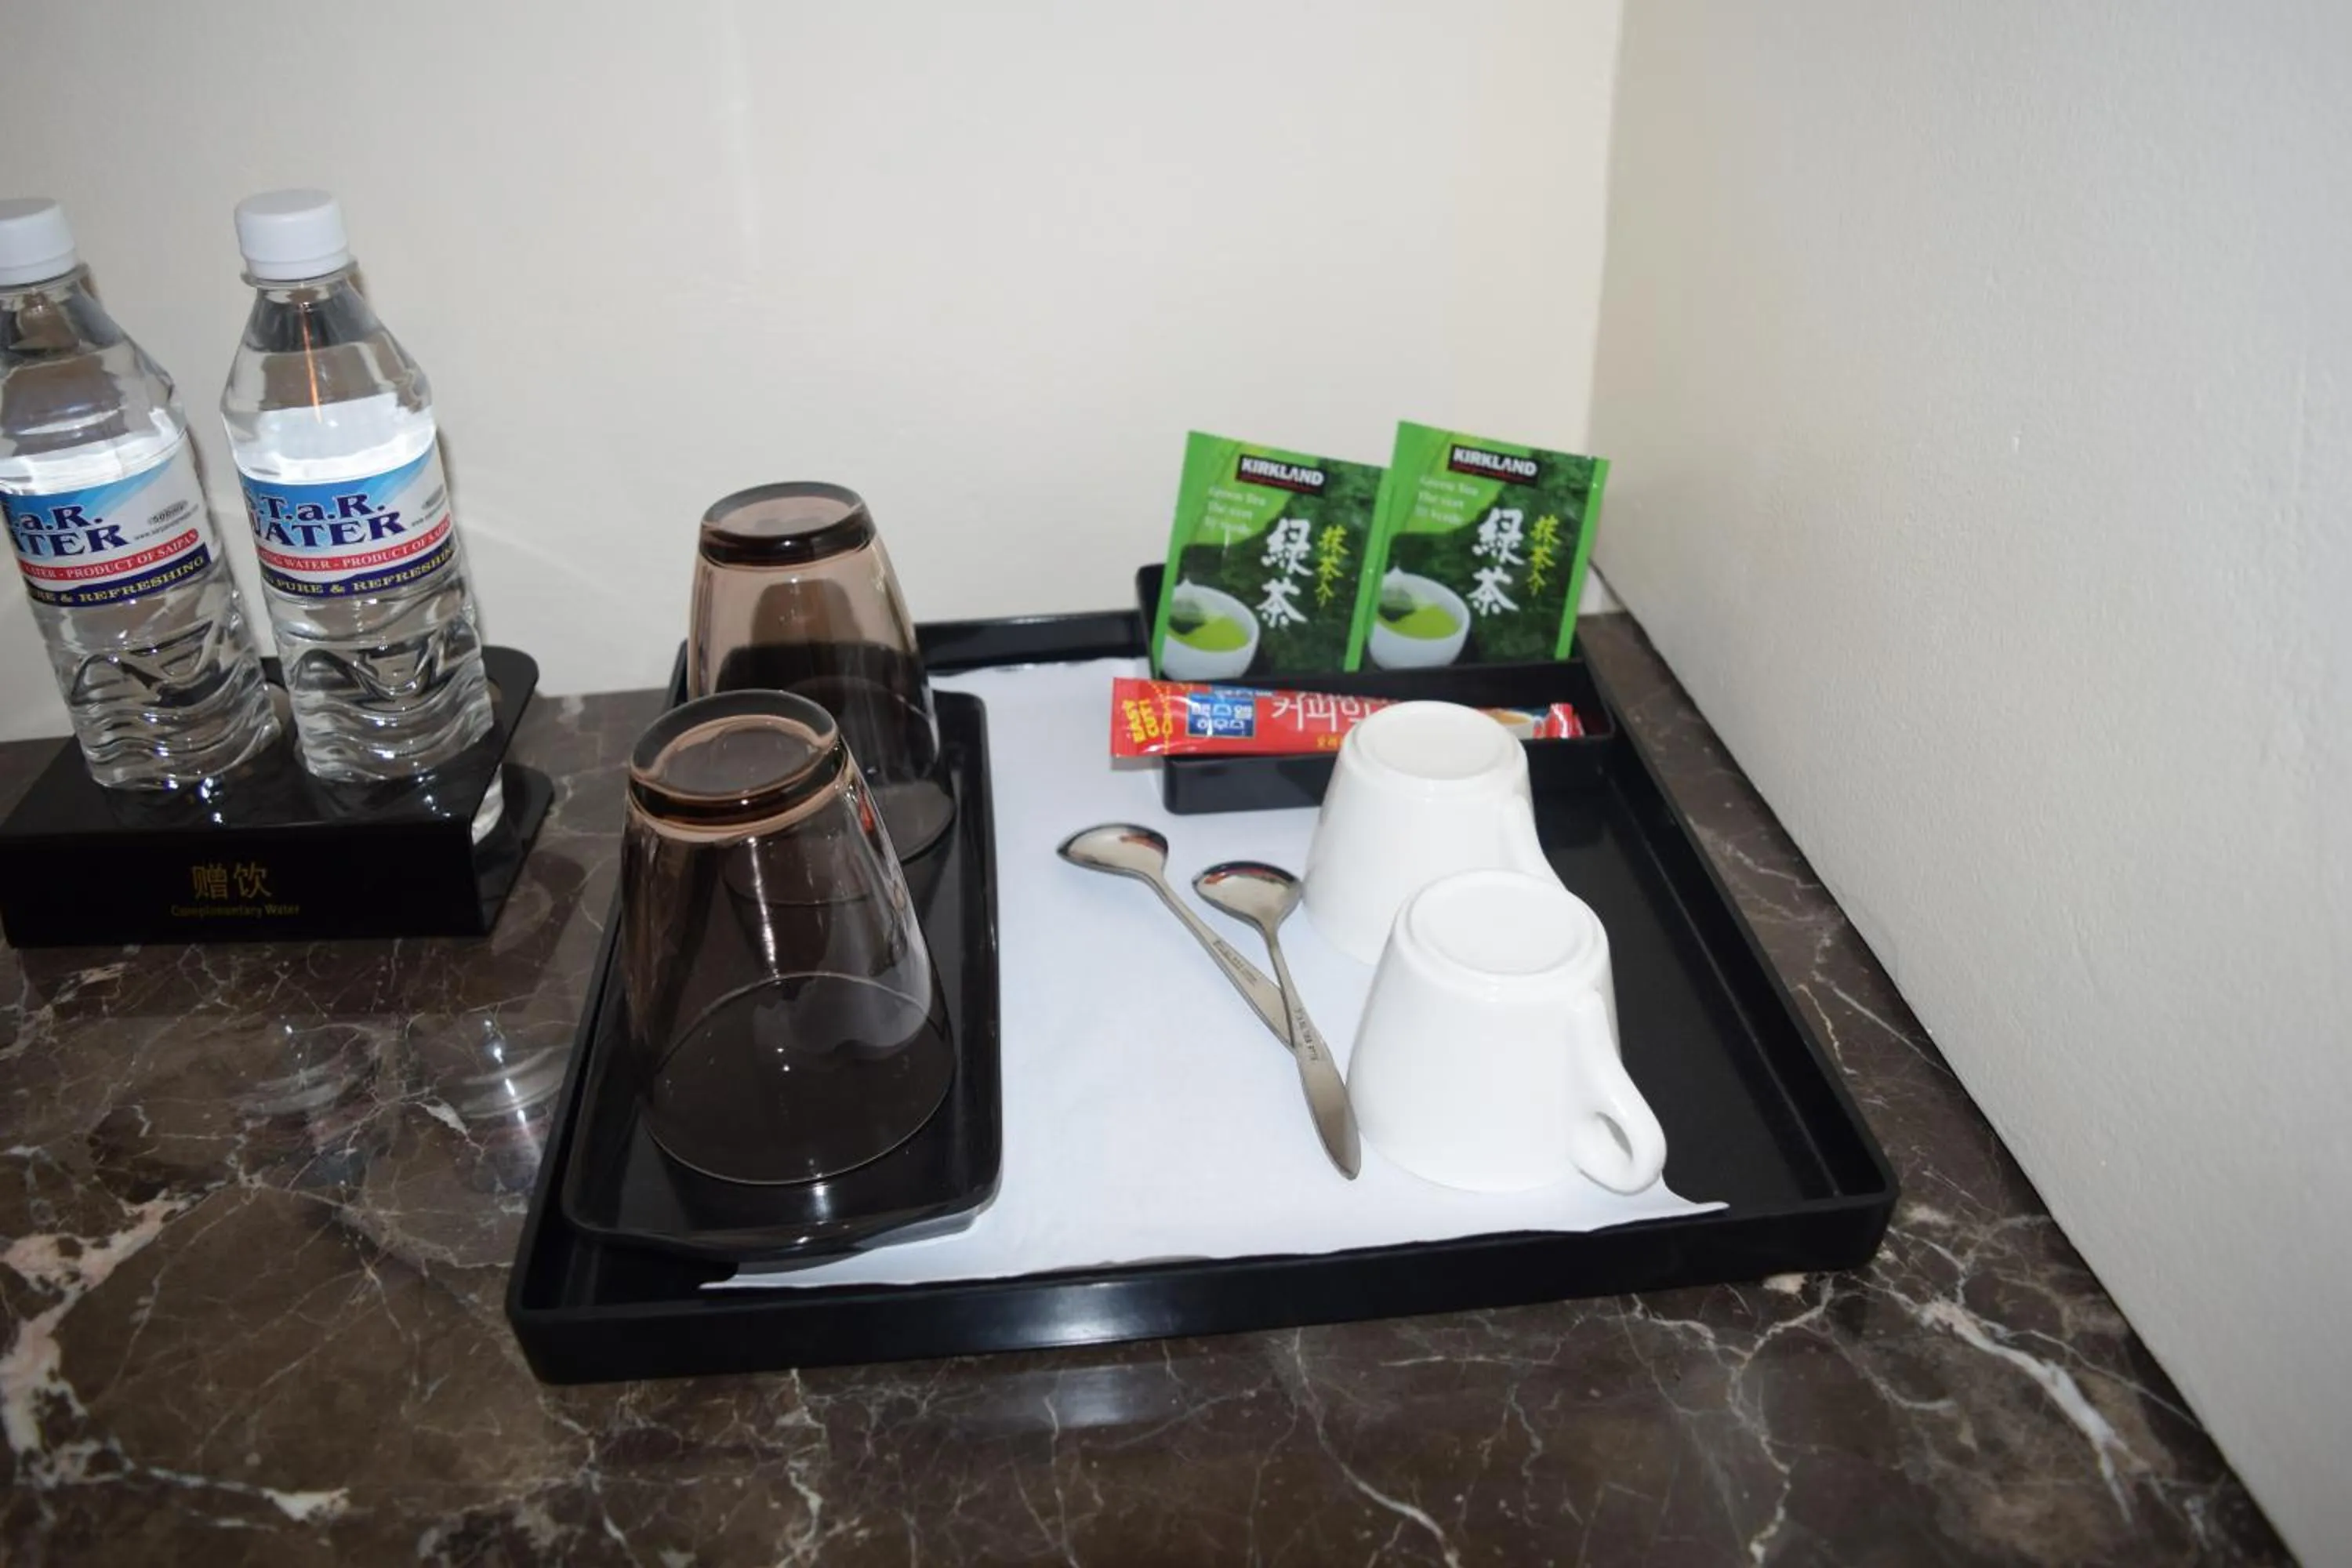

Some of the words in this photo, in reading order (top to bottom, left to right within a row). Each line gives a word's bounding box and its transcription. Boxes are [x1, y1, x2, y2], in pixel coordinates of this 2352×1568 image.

[1241, 457, 1325, 486] KIRKLAND
[1453, 447, 1537, 477] KIRKLAND
[12, 524, 129, 556] TER
[66, 557, 132, 578] PRODUCT
[137, 552, 154, 564] OF
[158, 532, 198, 557] SAIPAN
[285, 557, 331, 569] WATER
[343, 546, 408, 567] PRODUCT
[412, 539, 425, 550] OF
[80, 557, 203, 602] REFRESHING
[1272, 691, 1371, 731] 커피믹
[191, 862, 272, 900] 赠饮
[264, 903, 299, 916] Water
